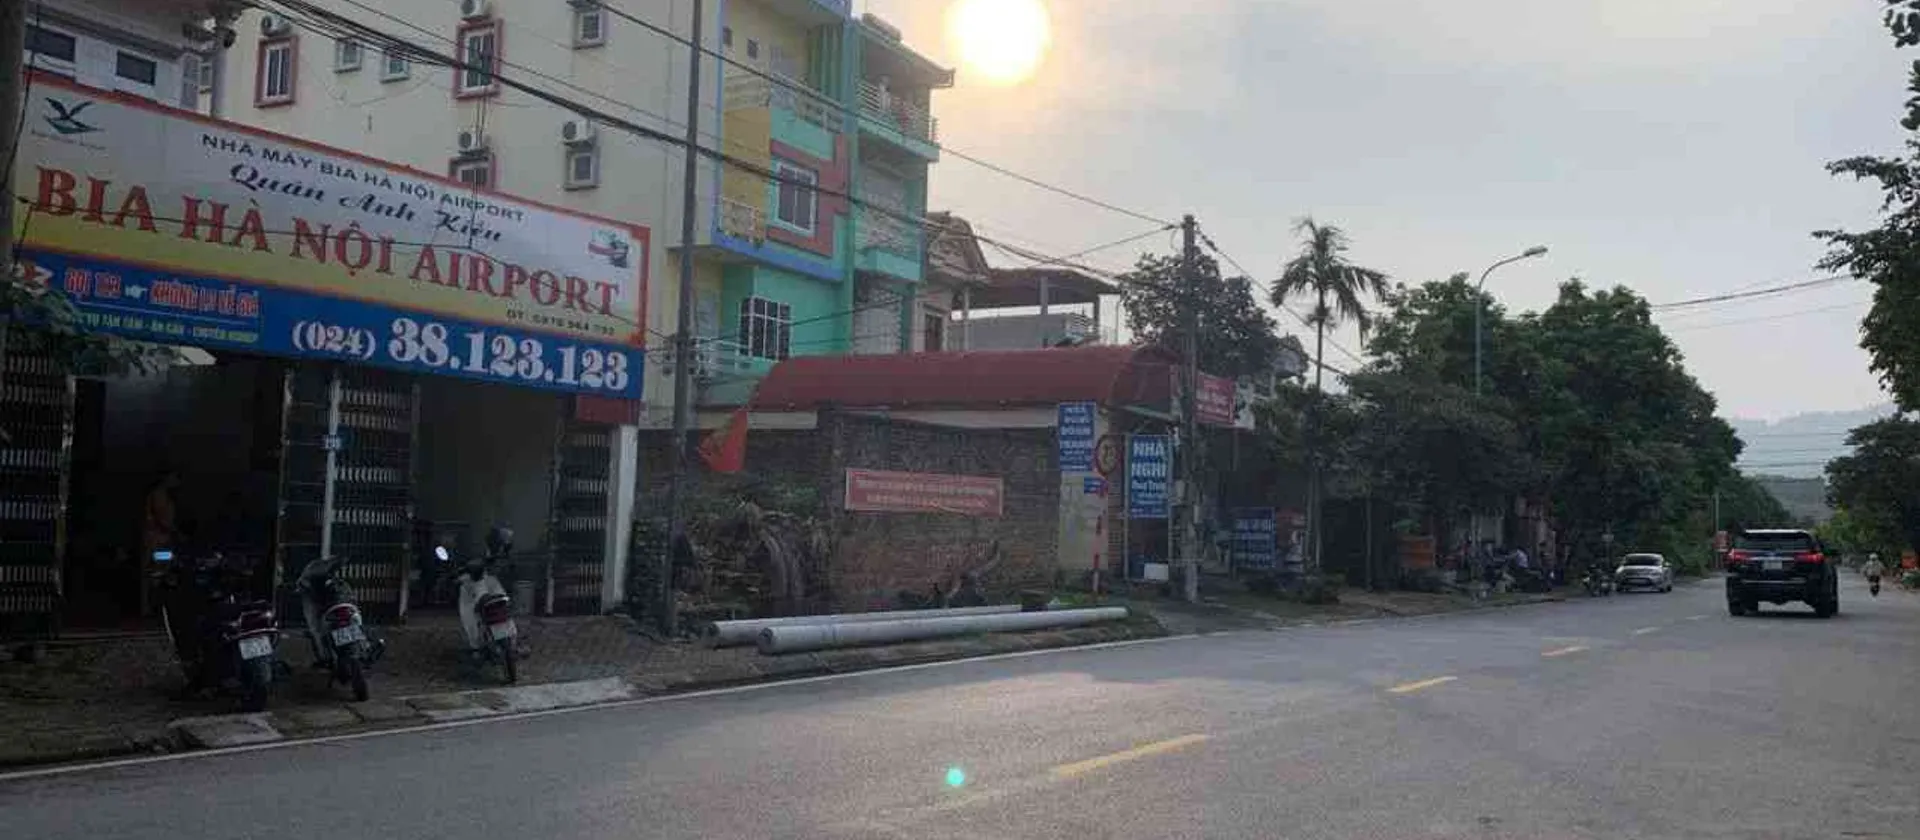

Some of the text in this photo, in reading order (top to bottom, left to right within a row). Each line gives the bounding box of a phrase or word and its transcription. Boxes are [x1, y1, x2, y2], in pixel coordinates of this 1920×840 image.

[229, 162, 325, 202] Quán
[339, 193, 416, 222] Anh
[320, 161, 357, 181] BIA
[439, 193, 525, 222] AIRPORT
[34, 164, 620, 318] BIA HÀ NỘI AIRPORT
[292, 317, 629, 392] (024) 38.123.123
